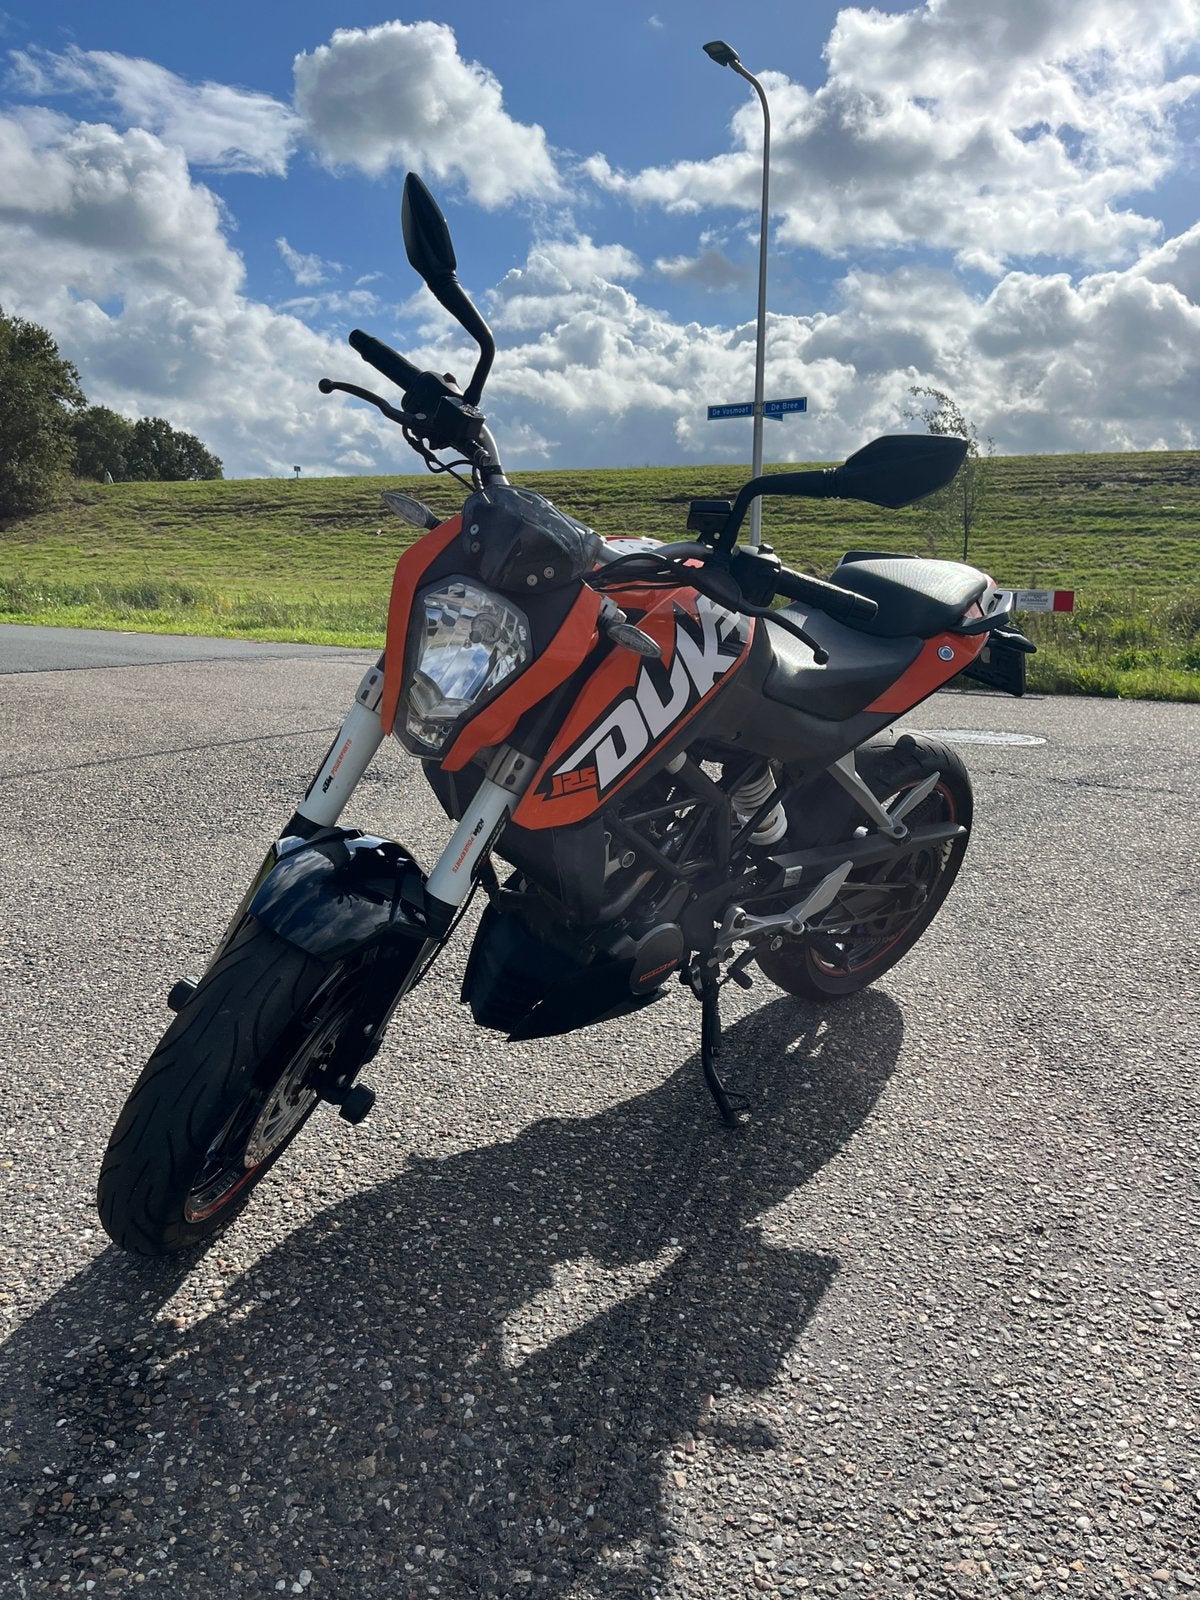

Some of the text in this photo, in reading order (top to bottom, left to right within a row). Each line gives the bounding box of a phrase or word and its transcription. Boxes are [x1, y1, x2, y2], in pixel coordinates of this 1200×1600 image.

[712, 408, 720, 416] De
[771, 402, 798, 411] De Bree
[322, 775, 334, 794] KTM
[551, 765, 597, 796] 125
[473, 818, 485, 836] KTM
